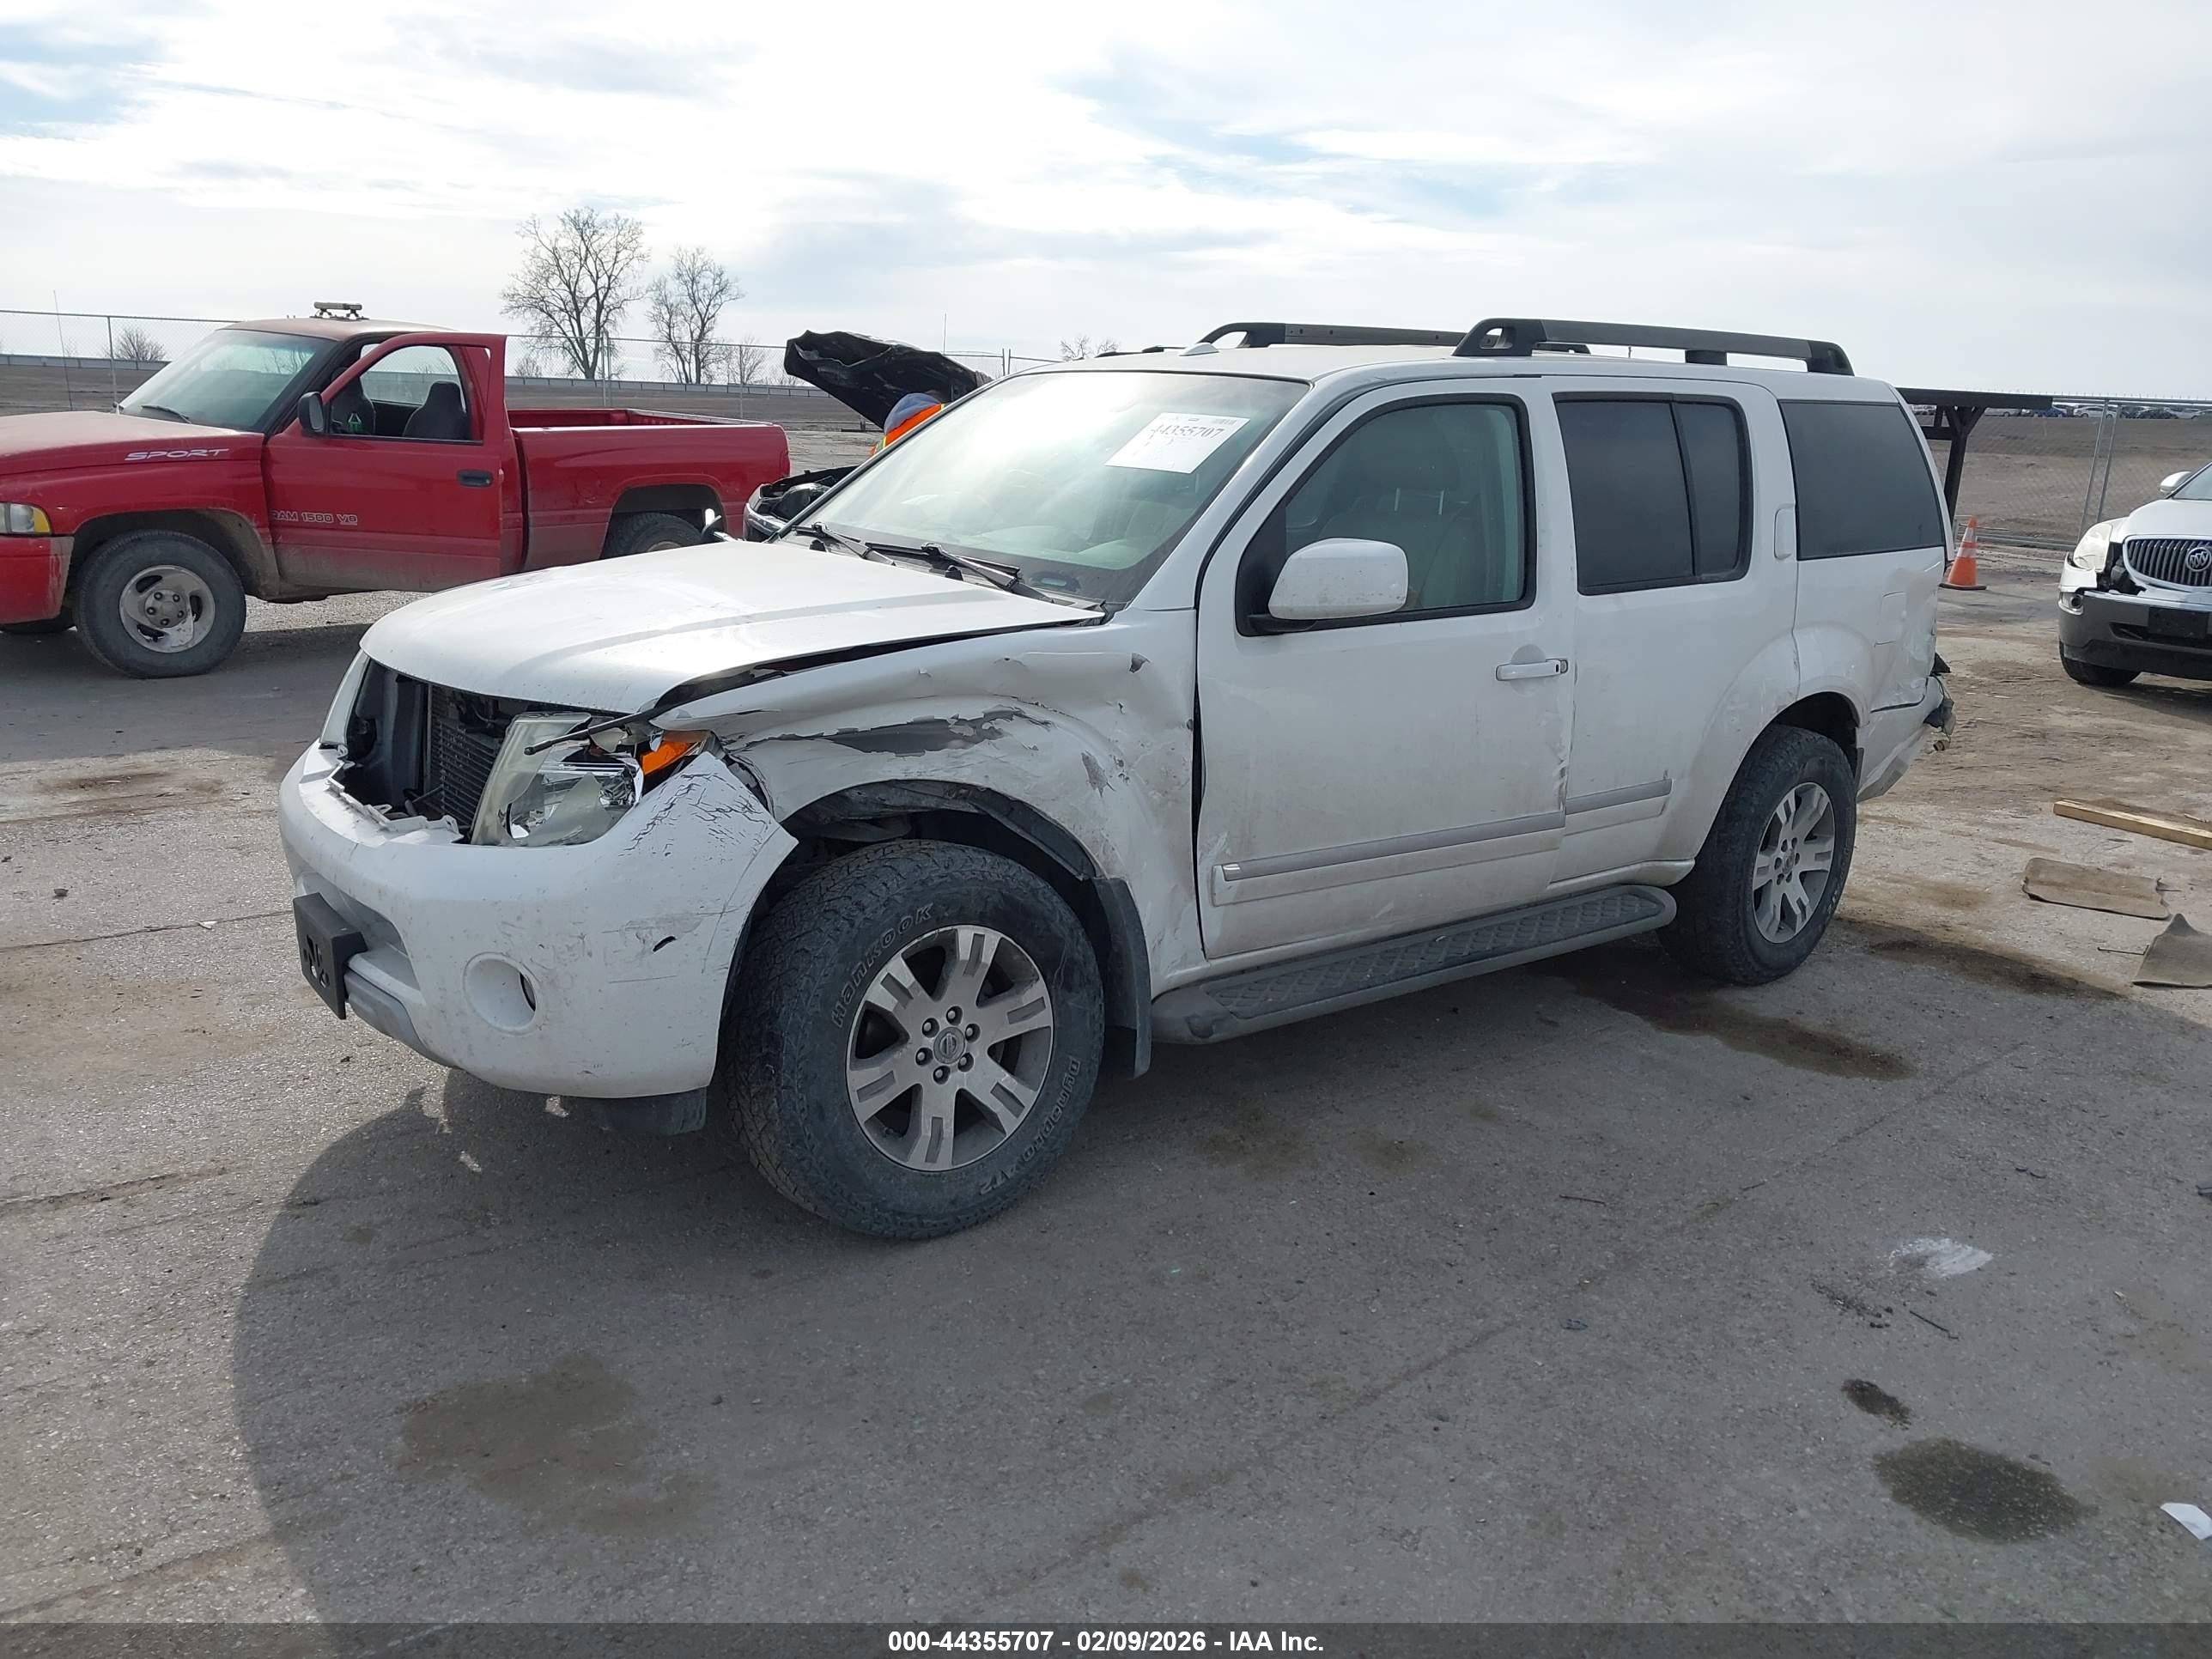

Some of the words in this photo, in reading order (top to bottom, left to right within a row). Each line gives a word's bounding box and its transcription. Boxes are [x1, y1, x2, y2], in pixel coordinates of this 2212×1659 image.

[125, 448, 229, 461] SPORT
[301, 512, 334, 524] 1500
[337, 514, 358, 524] V8
